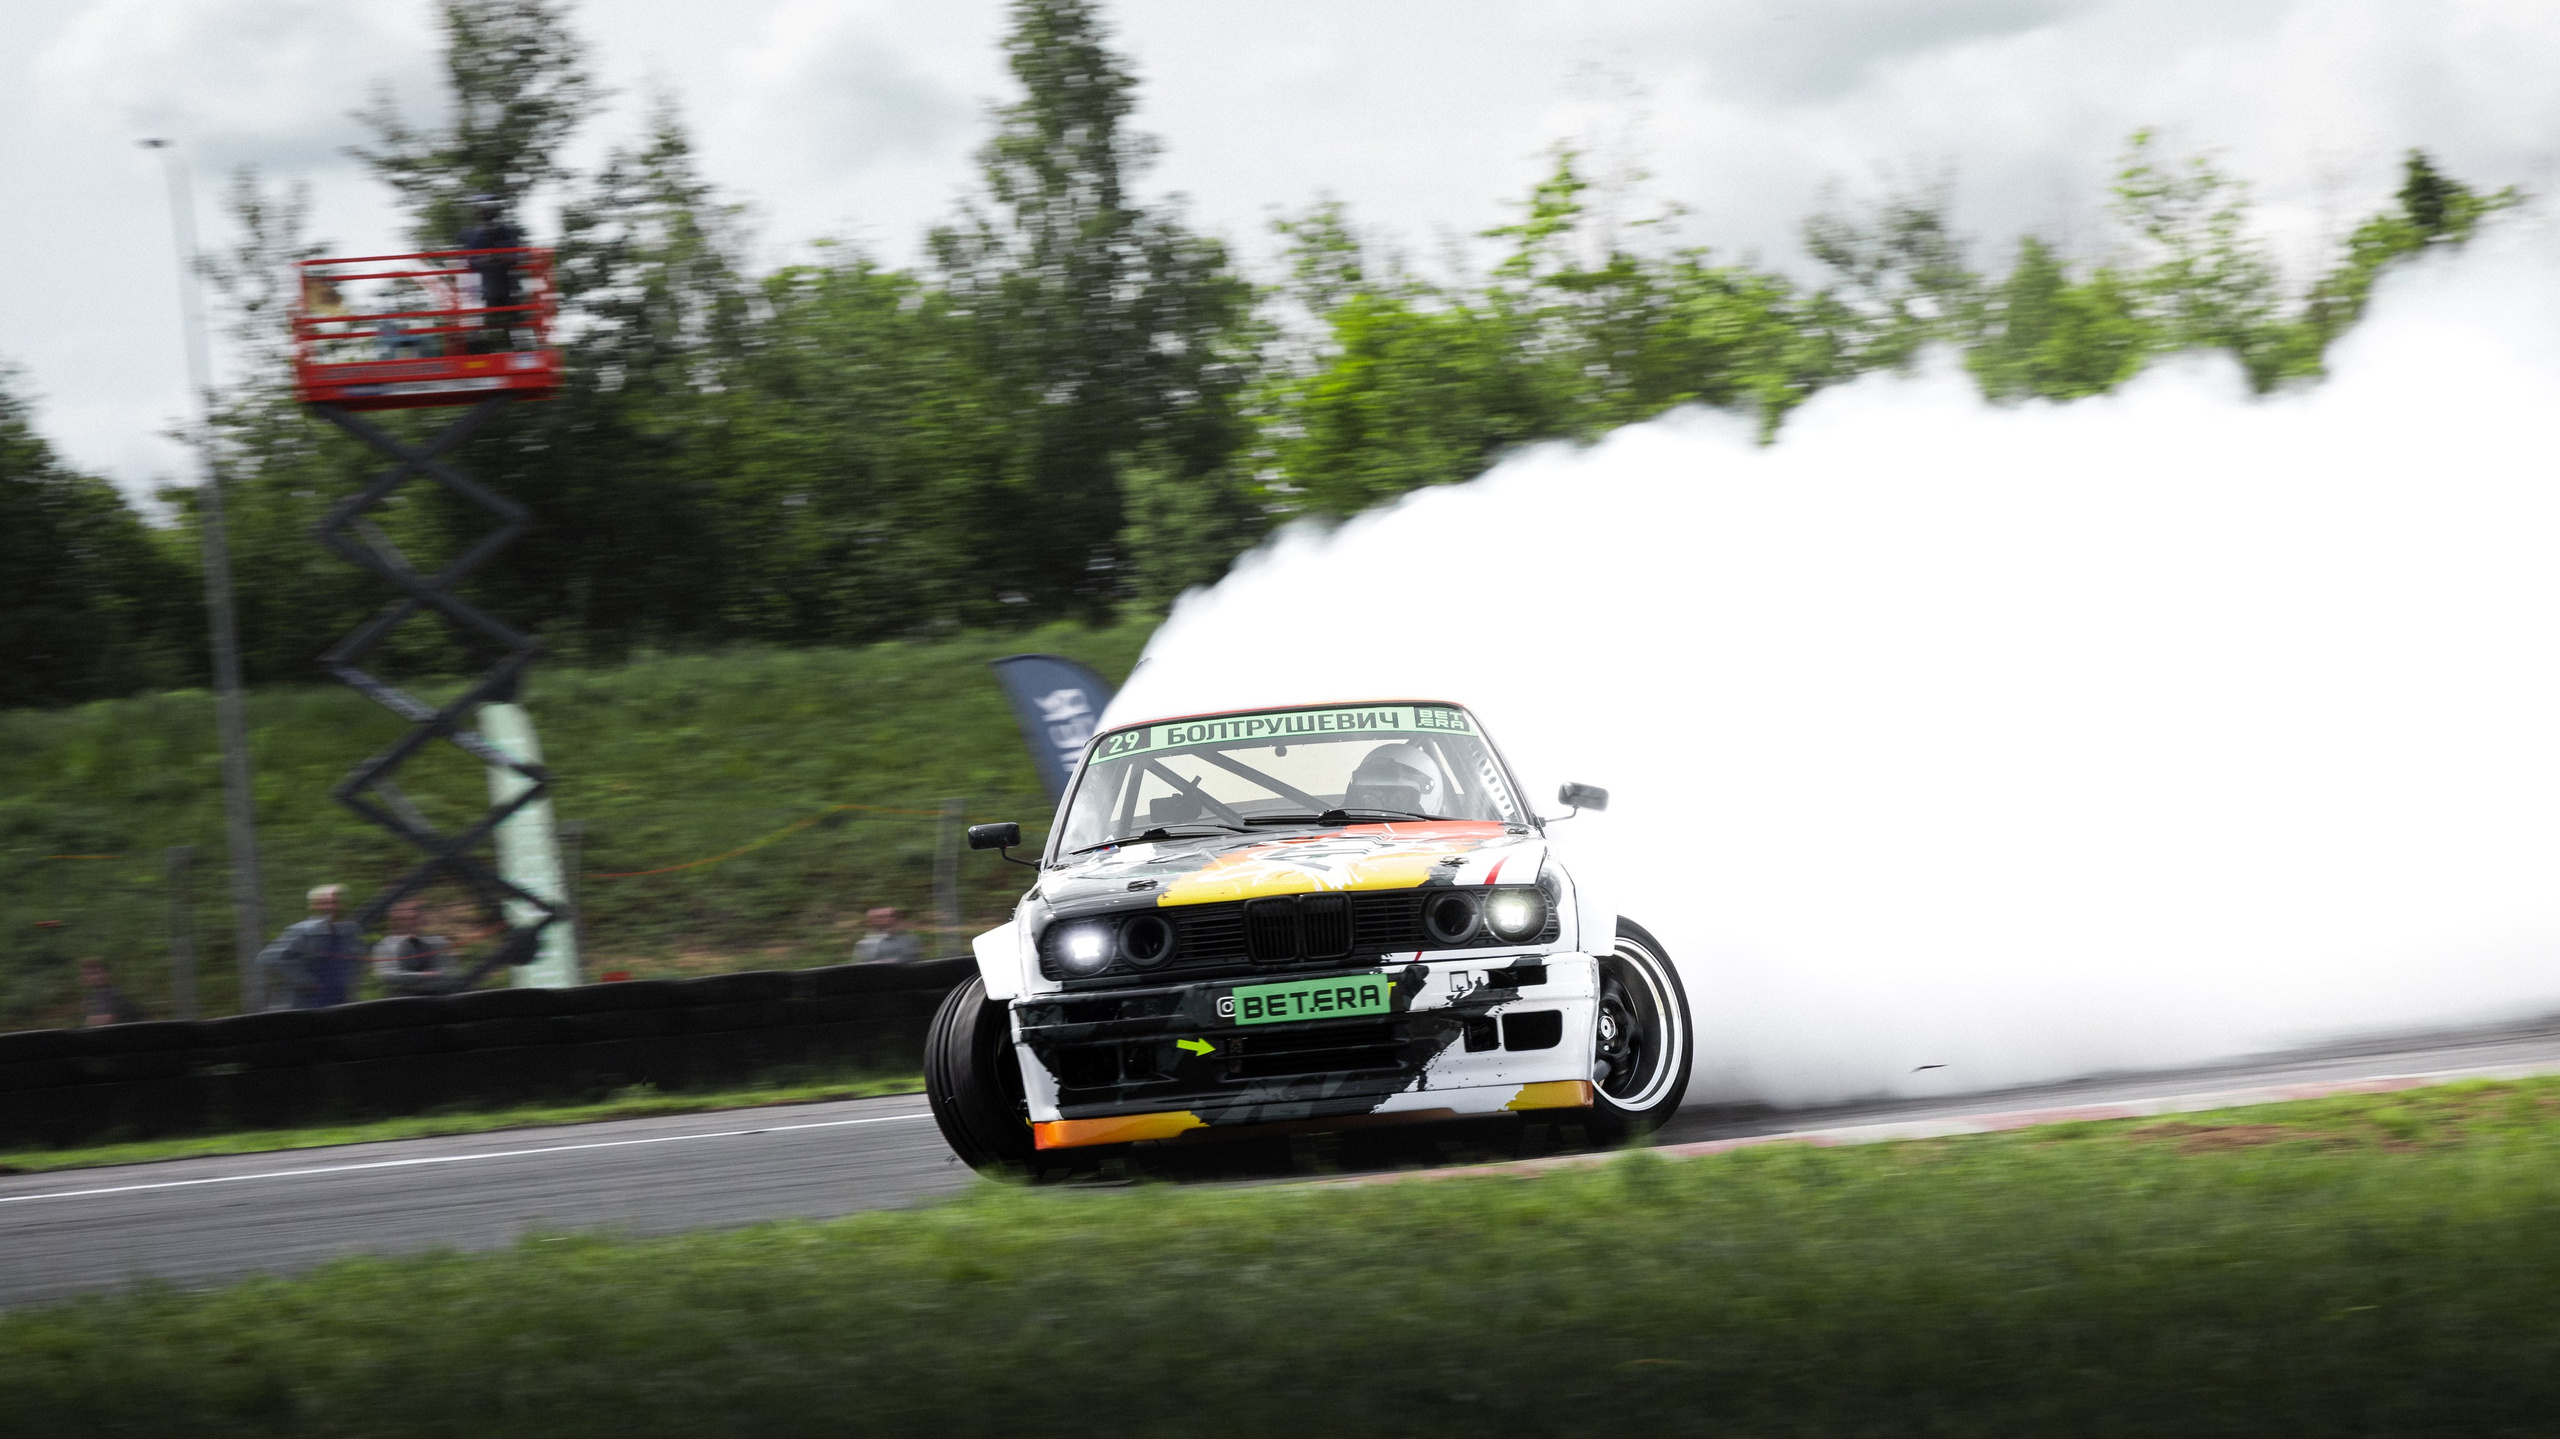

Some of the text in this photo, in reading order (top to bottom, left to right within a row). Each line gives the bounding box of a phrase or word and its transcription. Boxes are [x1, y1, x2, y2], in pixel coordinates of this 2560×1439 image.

[1166, 711, 1400, 746] БОЛТРУШЕВИЧ
[1418, 709, 1463, 721] BET
[1108, 731, 1141, 755] 29
[1243, 984, 1381, 1020] BET.ERA
